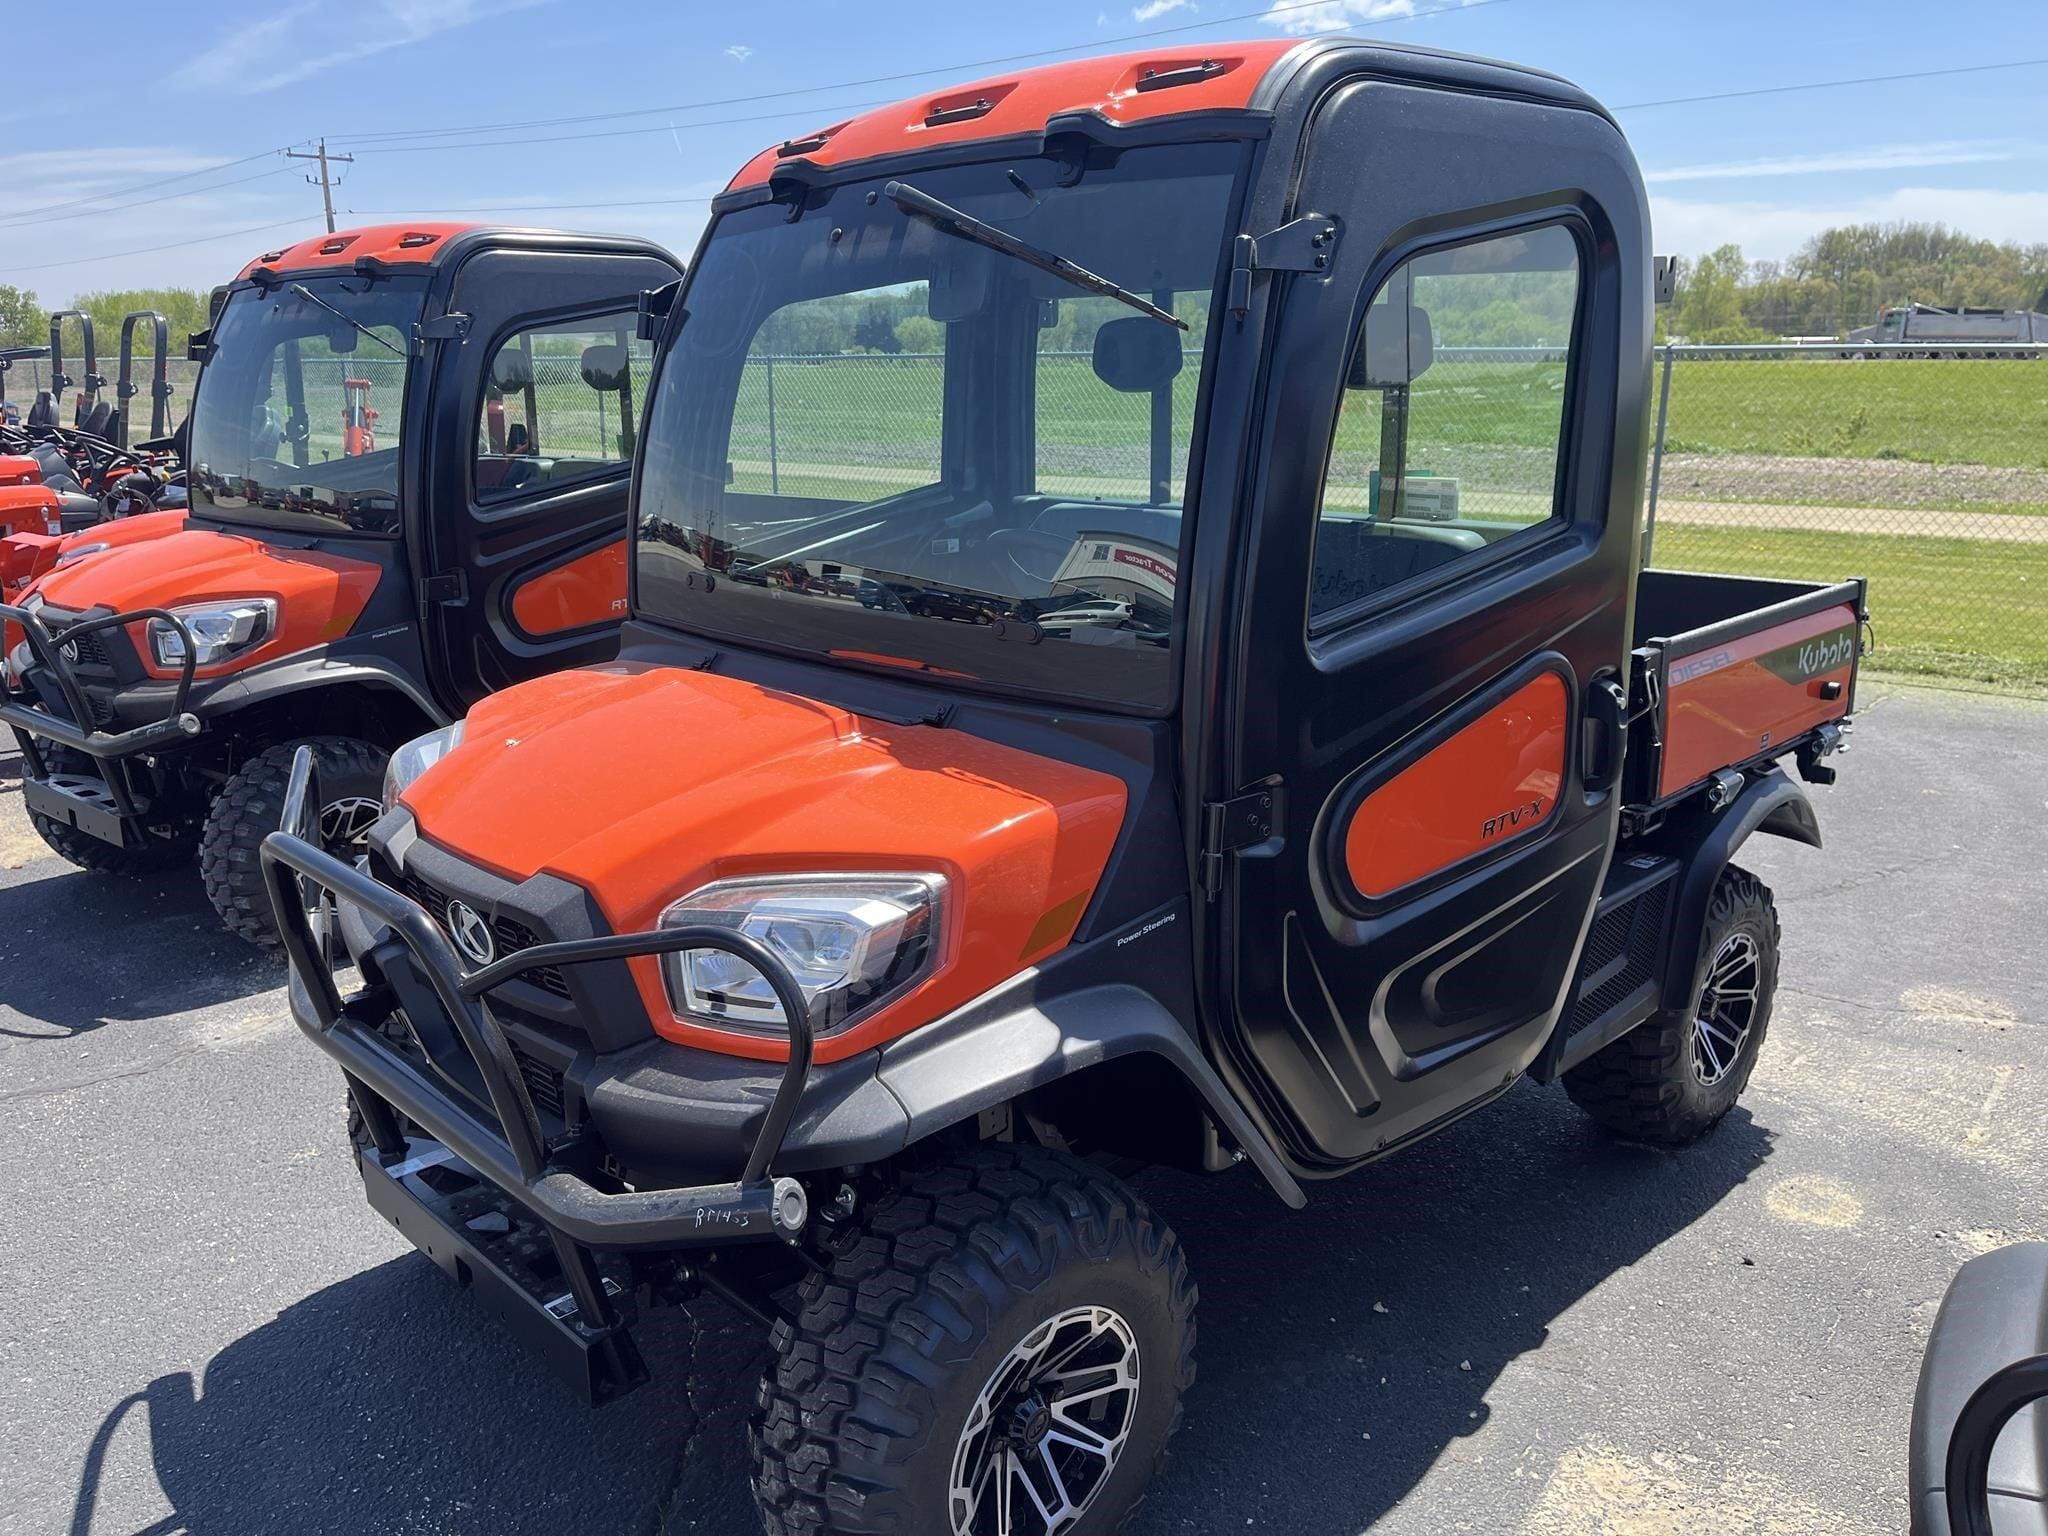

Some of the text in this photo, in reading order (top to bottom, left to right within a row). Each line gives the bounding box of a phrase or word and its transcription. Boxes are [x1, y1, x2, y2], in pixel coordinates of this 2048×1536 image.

[1671, 651, 1735, 684] DIESEL
[1798, 632, 1852, 674] Kubota
[1481, 796, 1544, 840] RTV-X
[1117, 913, 1175, 948] Power Steering
